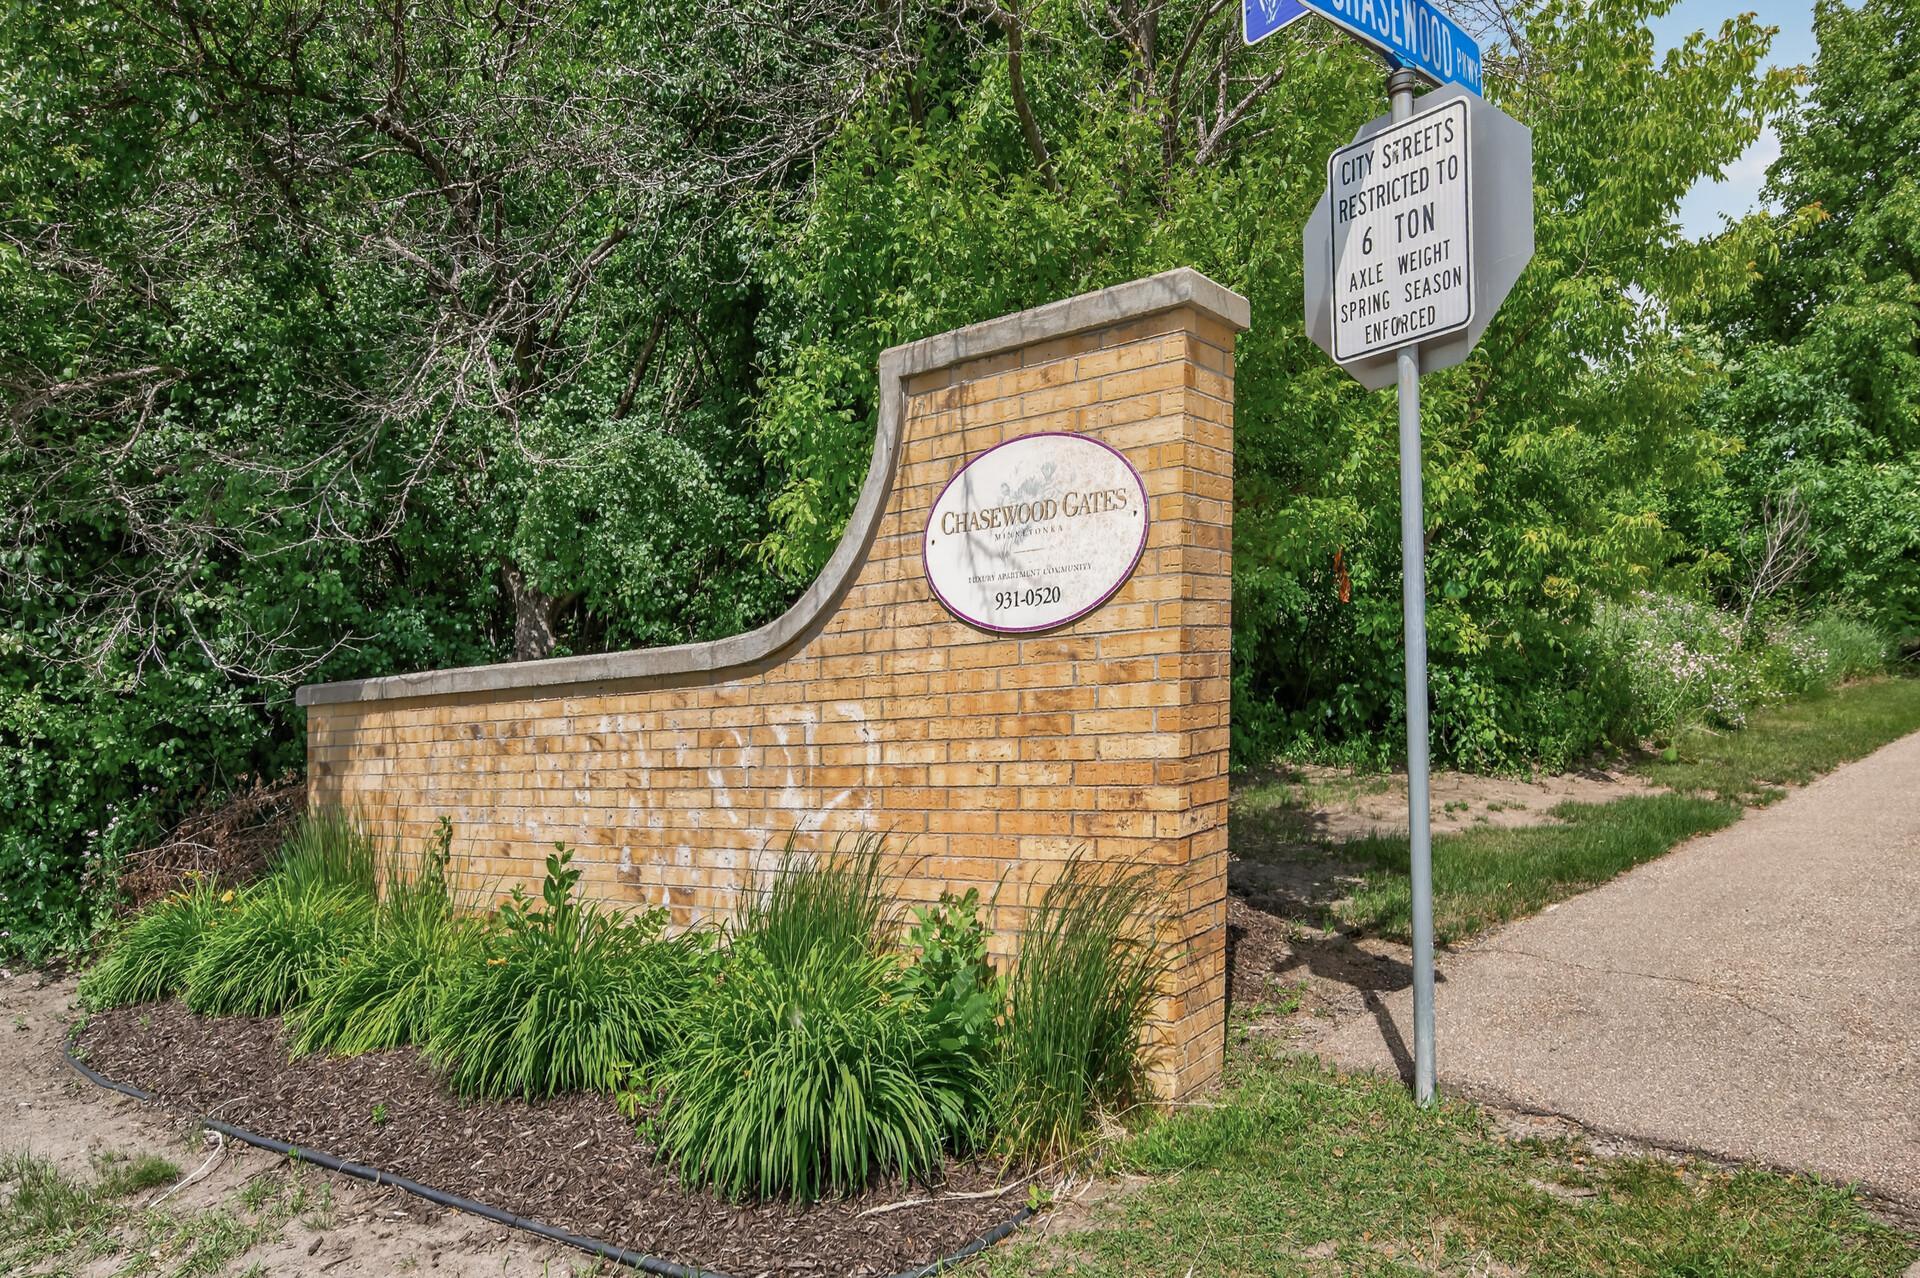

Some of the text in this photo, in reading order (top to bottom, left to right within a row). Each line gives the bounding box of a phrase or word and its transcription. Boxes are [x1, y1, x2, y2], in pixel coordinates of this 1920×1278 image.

[1332, 0, 1478, 87] ASEWOOD PKWY
[1342, 117, 1454, 185] CITY STREETS
[1339, 154, 1458, 223] RESTRICTED TO
[1362, 201, 1435, 255] 6 TON
[1349, 239, 1450, 293] AXLE WEIGHT
[1341, 265, 1462, 323] SPRING SEASON
[1365, 305, 1436, 344] ENFORCED
[941, 487, 1128, 536] CHASEWOOD GATES
[995, 586, 1061, 611] 931-0520
[997, 568, 1041, 581] APARTMENT
[1043, 562, 1092, 575] COMMUNITY
